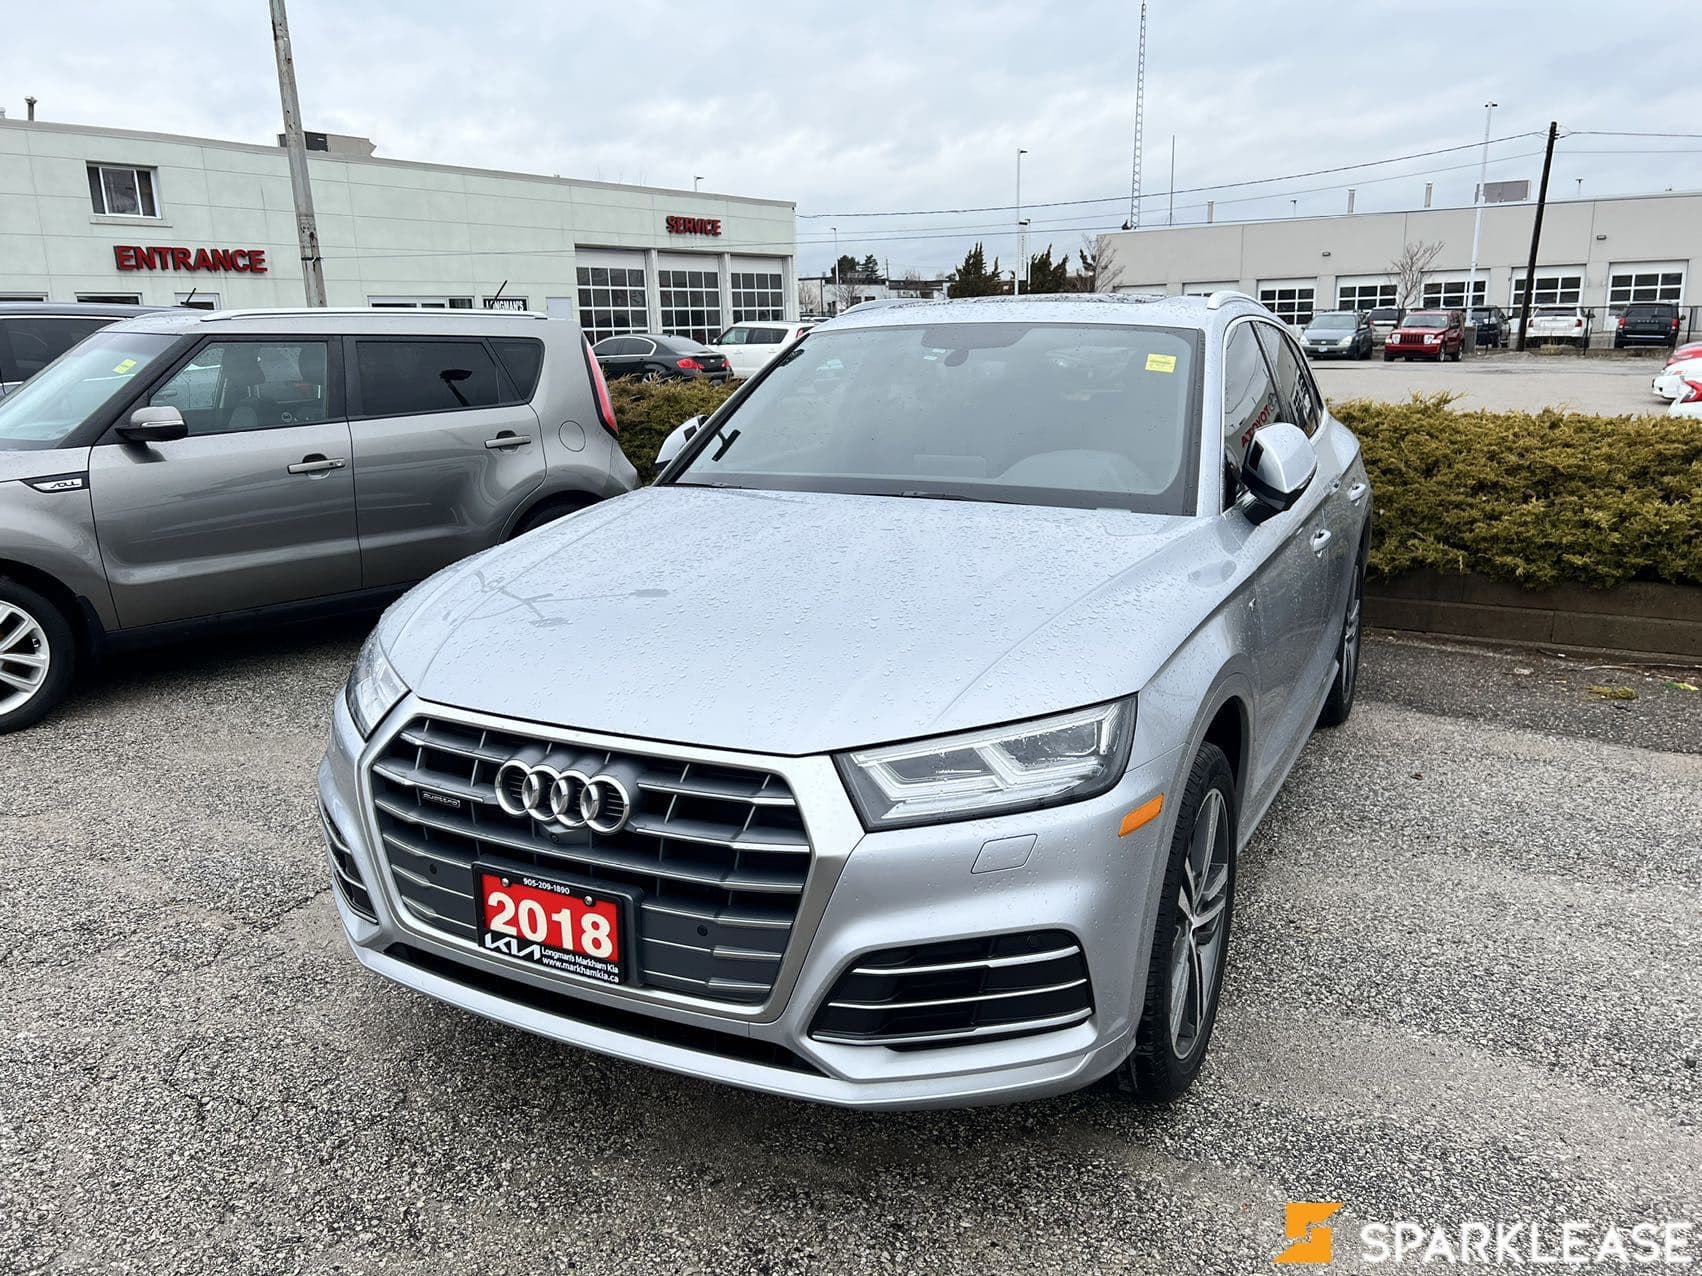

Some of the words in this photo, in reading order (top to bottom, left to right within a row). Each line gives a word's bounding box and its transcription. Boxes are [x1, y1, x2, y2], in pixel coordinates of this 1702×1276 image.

[665, 216, 722, 236] SERVICE
[113, 245, 268, 273] ENTRANCE
[523, 878, 570, 894] 905-209-1890
[488, 891, 613, 959] 2018
[542, 957, 619, 983] www.markhamkia.ca
[575, 955, 607, 970] Markham
[607, 963, 619, 974] Kia
